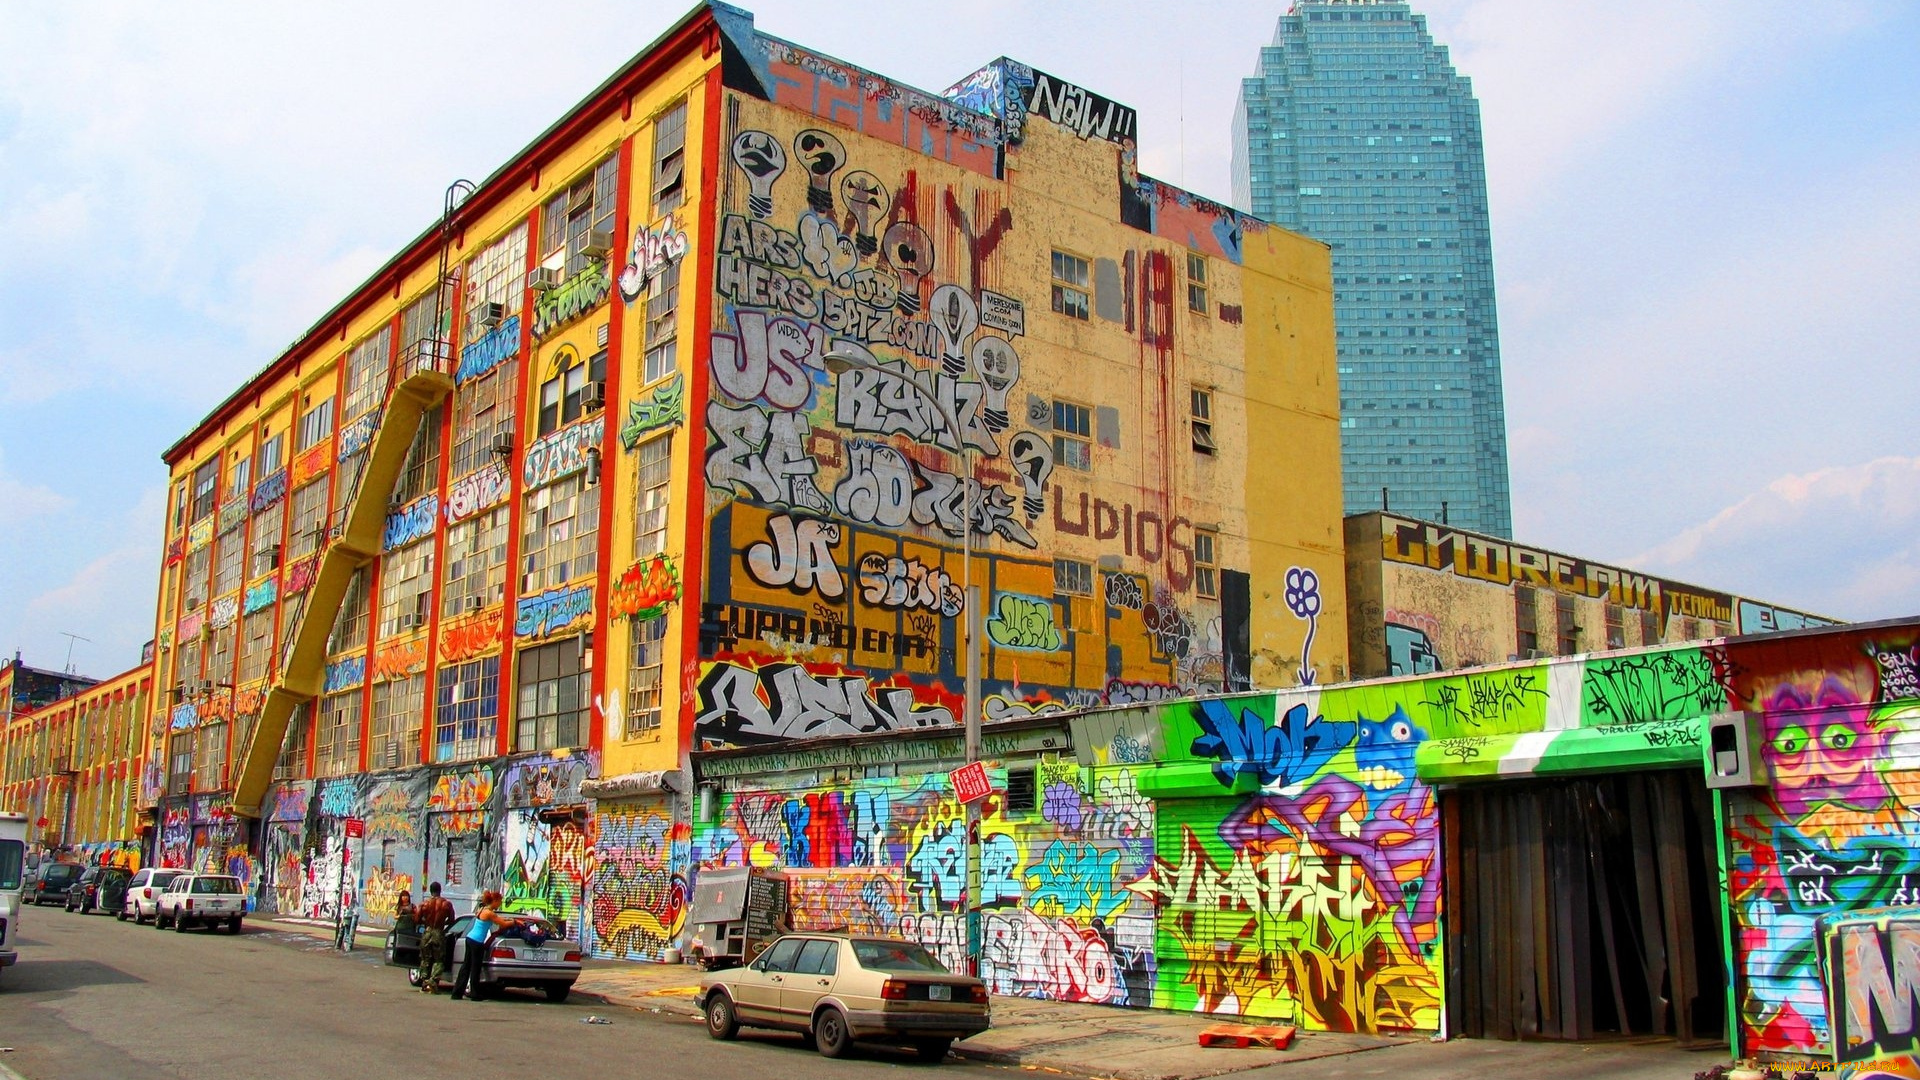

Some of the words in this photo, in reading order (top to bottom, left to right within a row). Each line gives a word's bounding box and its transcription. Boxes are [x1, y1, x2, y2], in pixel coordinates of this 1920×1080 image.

[717, 256, 818, 318] HERS
[1053, 485, 1195, 593] UDIOS
[980, 736, 1019, 751] THRAX!
